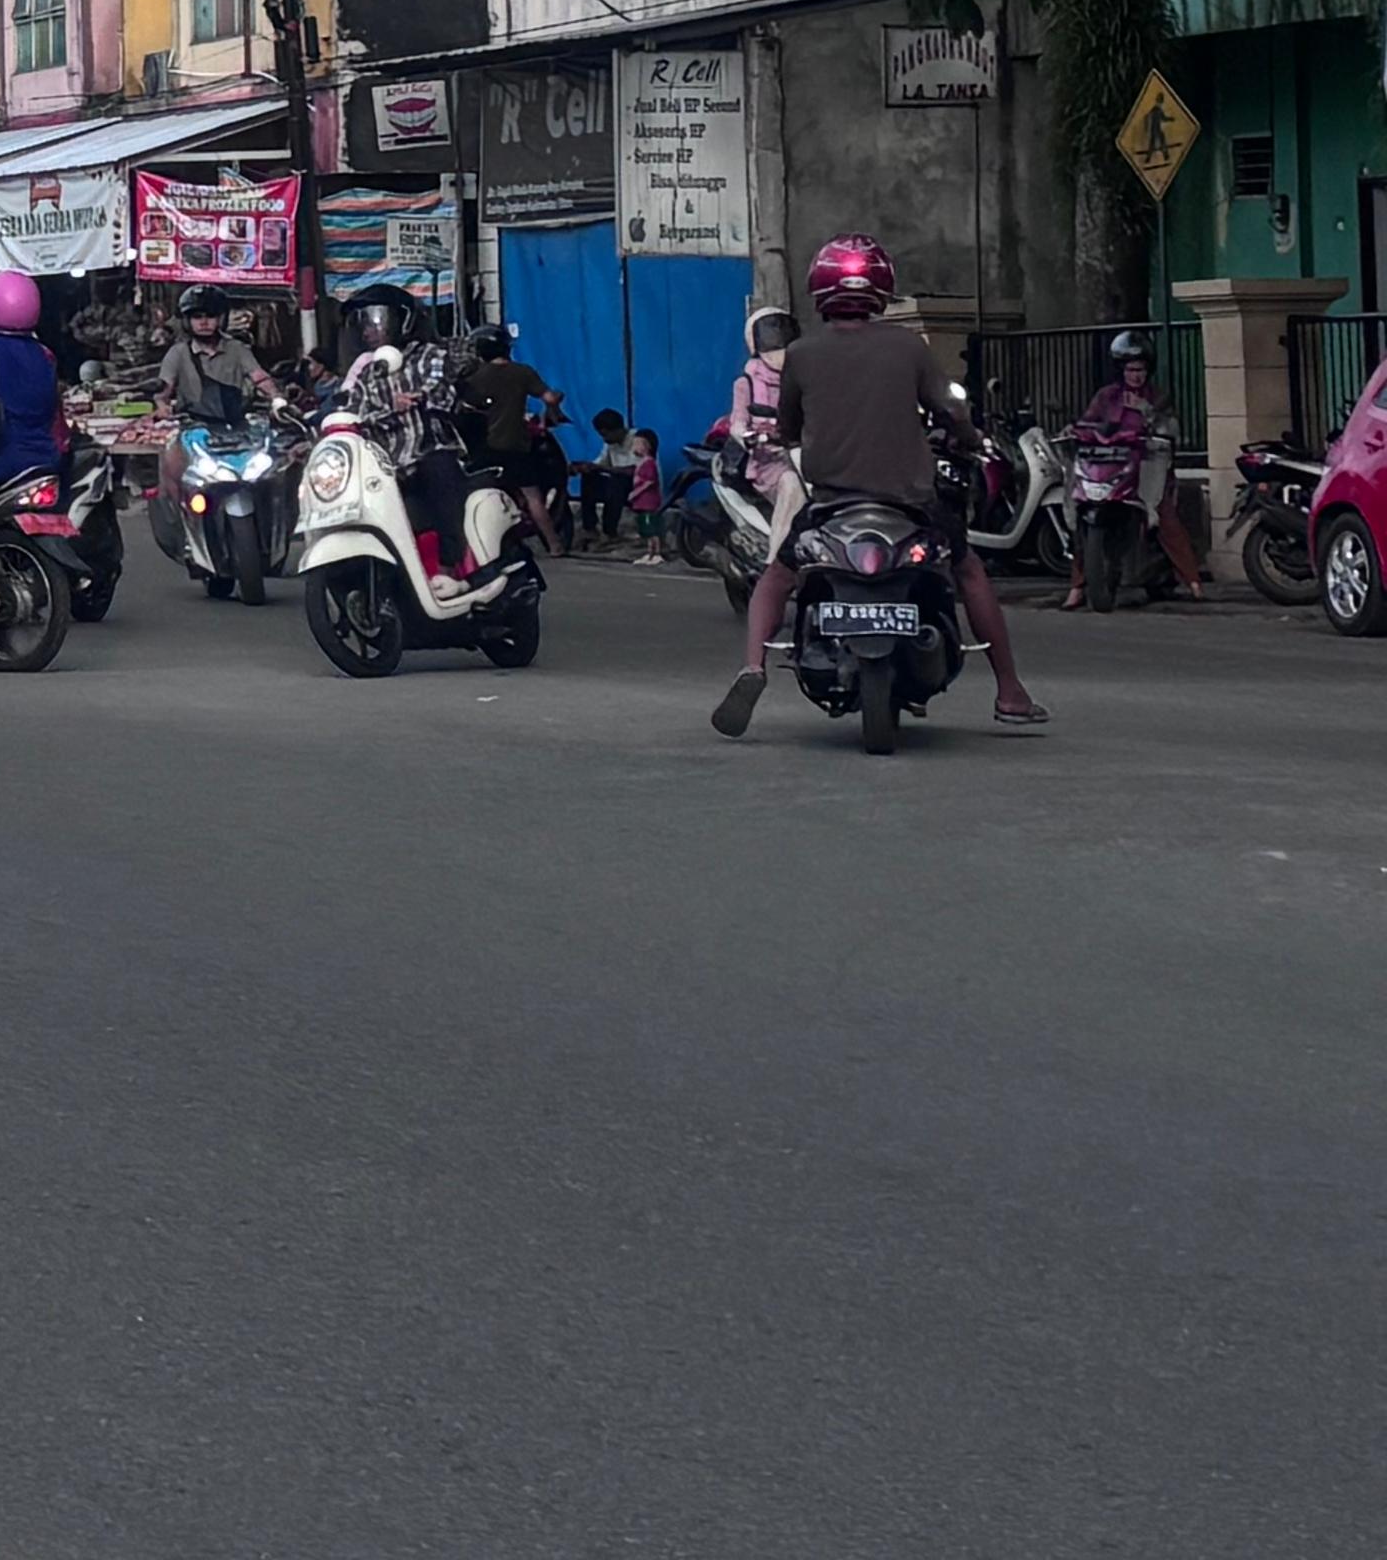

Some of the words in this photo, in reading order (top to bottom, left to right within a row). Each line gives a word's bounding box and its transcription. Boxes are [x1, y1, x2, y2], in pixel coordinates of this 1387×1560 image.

[650, 58, 670, 85] R
[681, 57, 721, 84] Cell
[545, 69, 606, 138] Cell
[901, 83, 925, 100] LA
